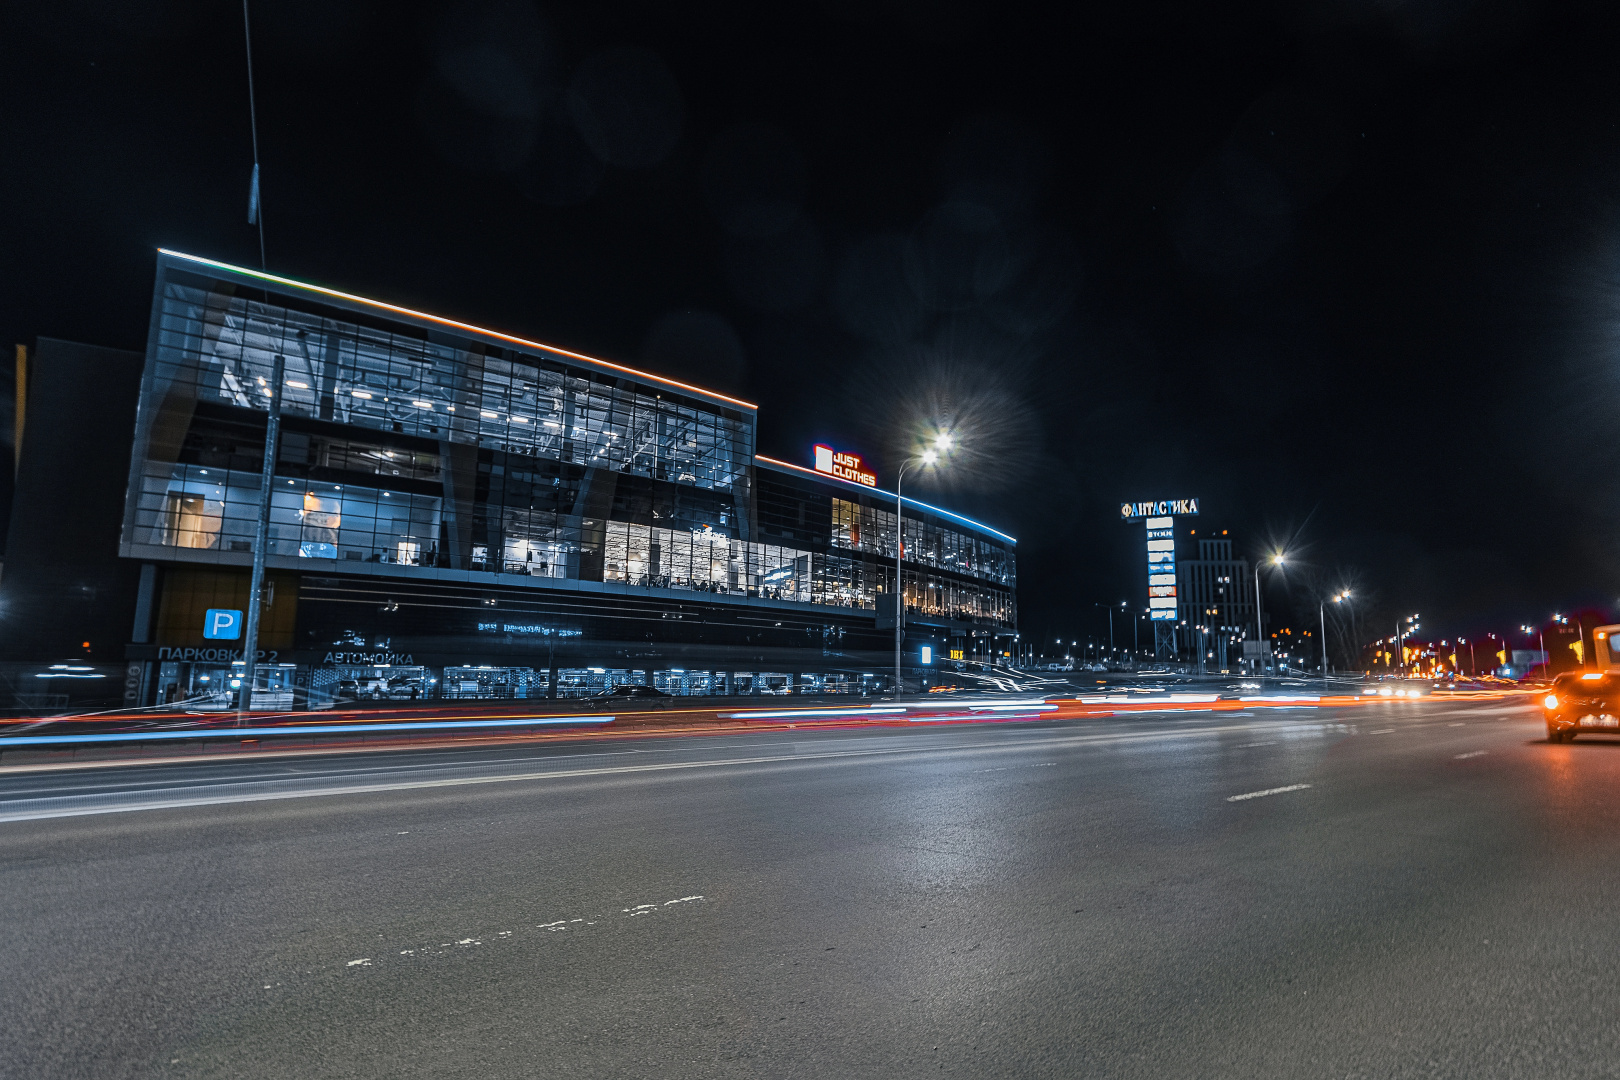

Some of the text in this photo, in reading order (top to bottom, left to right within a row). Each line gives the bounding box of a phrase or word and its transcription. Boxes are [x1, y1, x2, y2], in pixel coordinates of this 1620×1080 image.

[833, 452, 860, 469] JUST
[833, 464, 875, 486] CLOTHES
[1121, 499, 1198, 517] ФАНТАСТИКА
[213, 612, 234, 635] P
[268, 651, 278, 662] 2
[323, 650, 414, 665] АВТОМОЙКА
